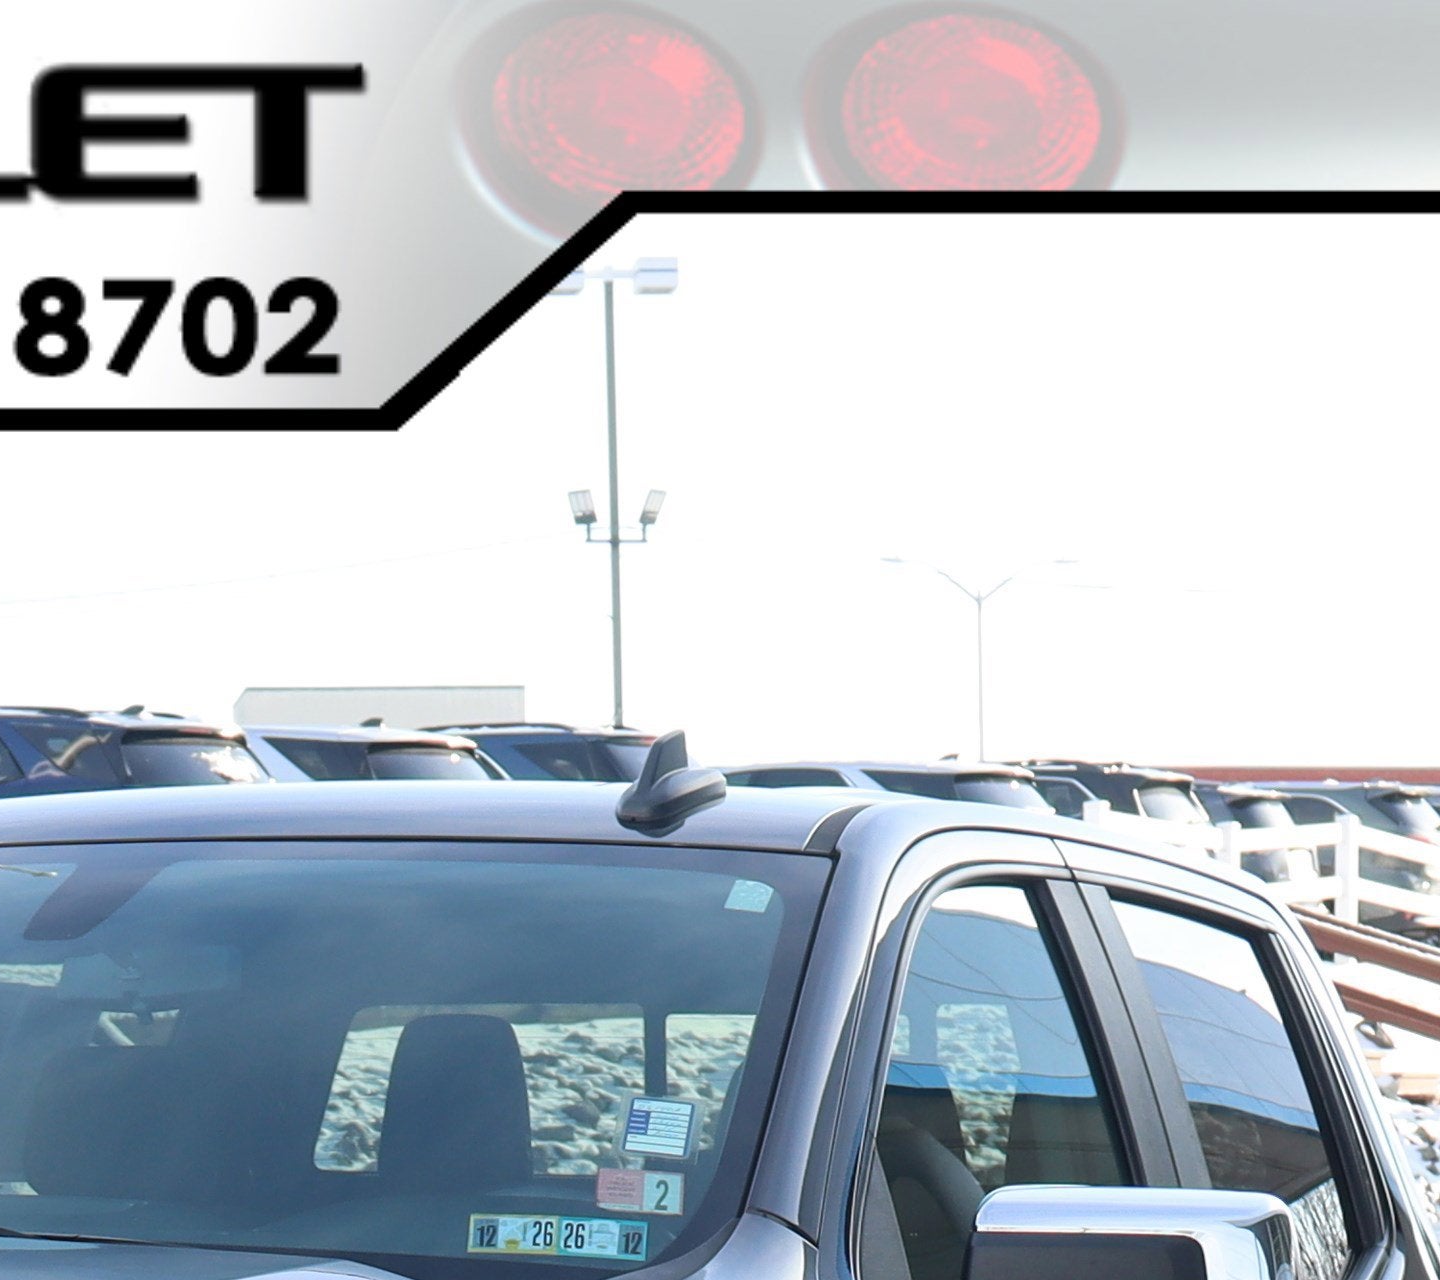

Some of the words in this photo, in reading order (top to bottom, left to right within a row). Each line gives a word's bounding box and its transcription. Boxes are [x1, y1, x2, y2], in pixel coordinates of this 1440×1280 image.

[654, 1179, 669, 1211] 2
[477, 1225, 497, 1247] 12
[532, 1221, 554, 1247] 26
[563, 1222, 586, 1249] 26
[623, 1231, 643, 1255] 12
